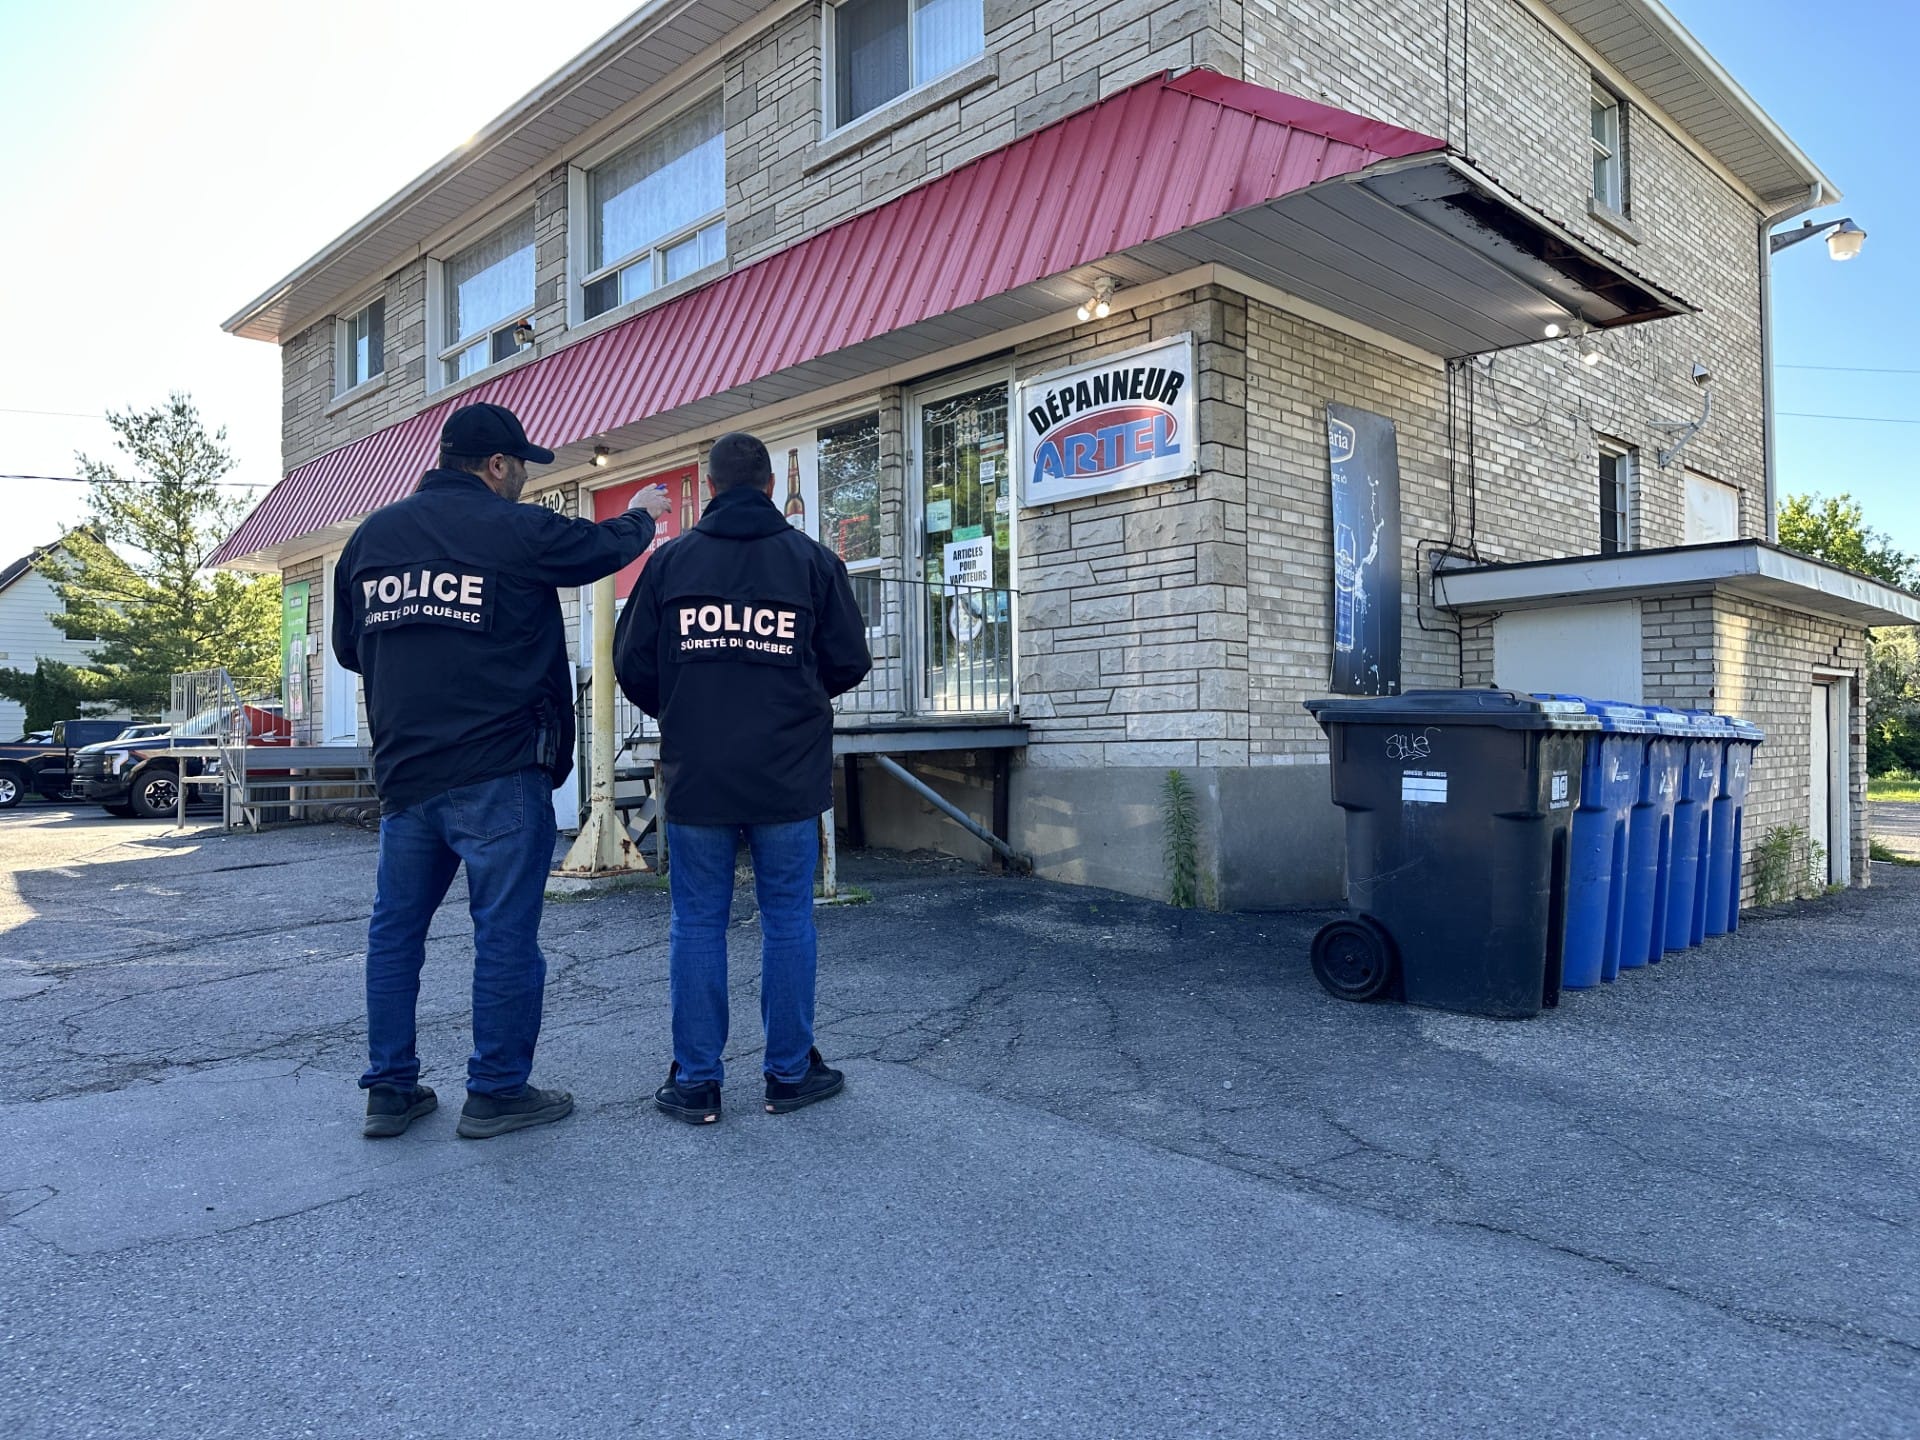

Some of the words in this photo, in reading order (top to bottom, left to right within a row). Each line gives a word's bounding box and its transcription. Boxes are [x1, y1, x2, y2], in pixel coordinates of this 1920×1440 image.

[1027, 367, 1185, 436] DÉPANNEUR
[1032, 414, 1181, 483] ARTEL
[952, 546, 983, 560] ARTICLES
[959, 559, 977, 571] POUR
[949, 569, 988, 585] VAPOTEURS
[362, 569, 484, 609] POLICE
[364, 607, 402, 626] SÛRETÉ
[402, 604, 419, 616] DU
[422, 604, 481, 624] QUÉBEC
[679, 604, 796, 639] POLICE
[680, 636, 727, 651] SÛRETÉ
[729, 637, 743, 648] DU
[745, 639, 793, 655] QUÉBEC
